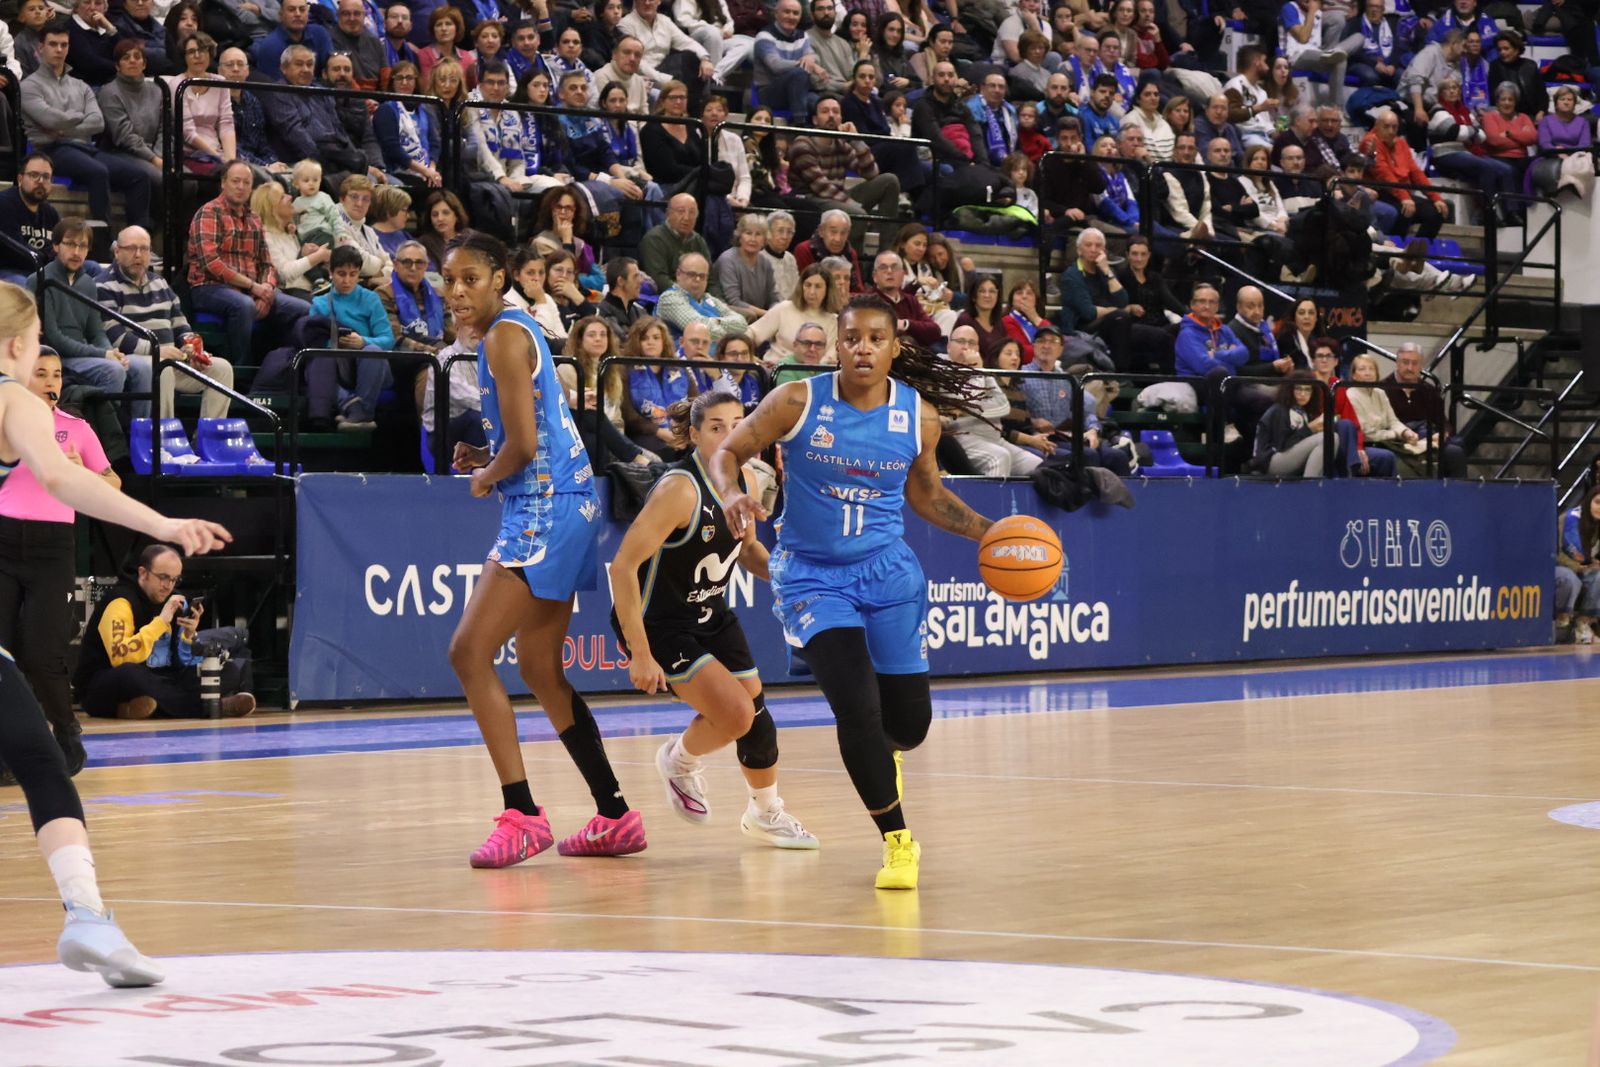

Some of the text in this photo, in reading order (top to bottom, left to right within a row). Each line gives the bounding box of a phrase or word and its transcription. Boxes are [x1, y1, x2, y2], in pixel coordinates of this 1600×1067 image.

[805, 451, 862, 468] CASTILLA
[867, 460, 876, 470] Y
[842, 503, 865, 537] 11
[928, 577, 986, 603] turismo
[1243, 574, 1541, 642] perfumeriasavenida.com
